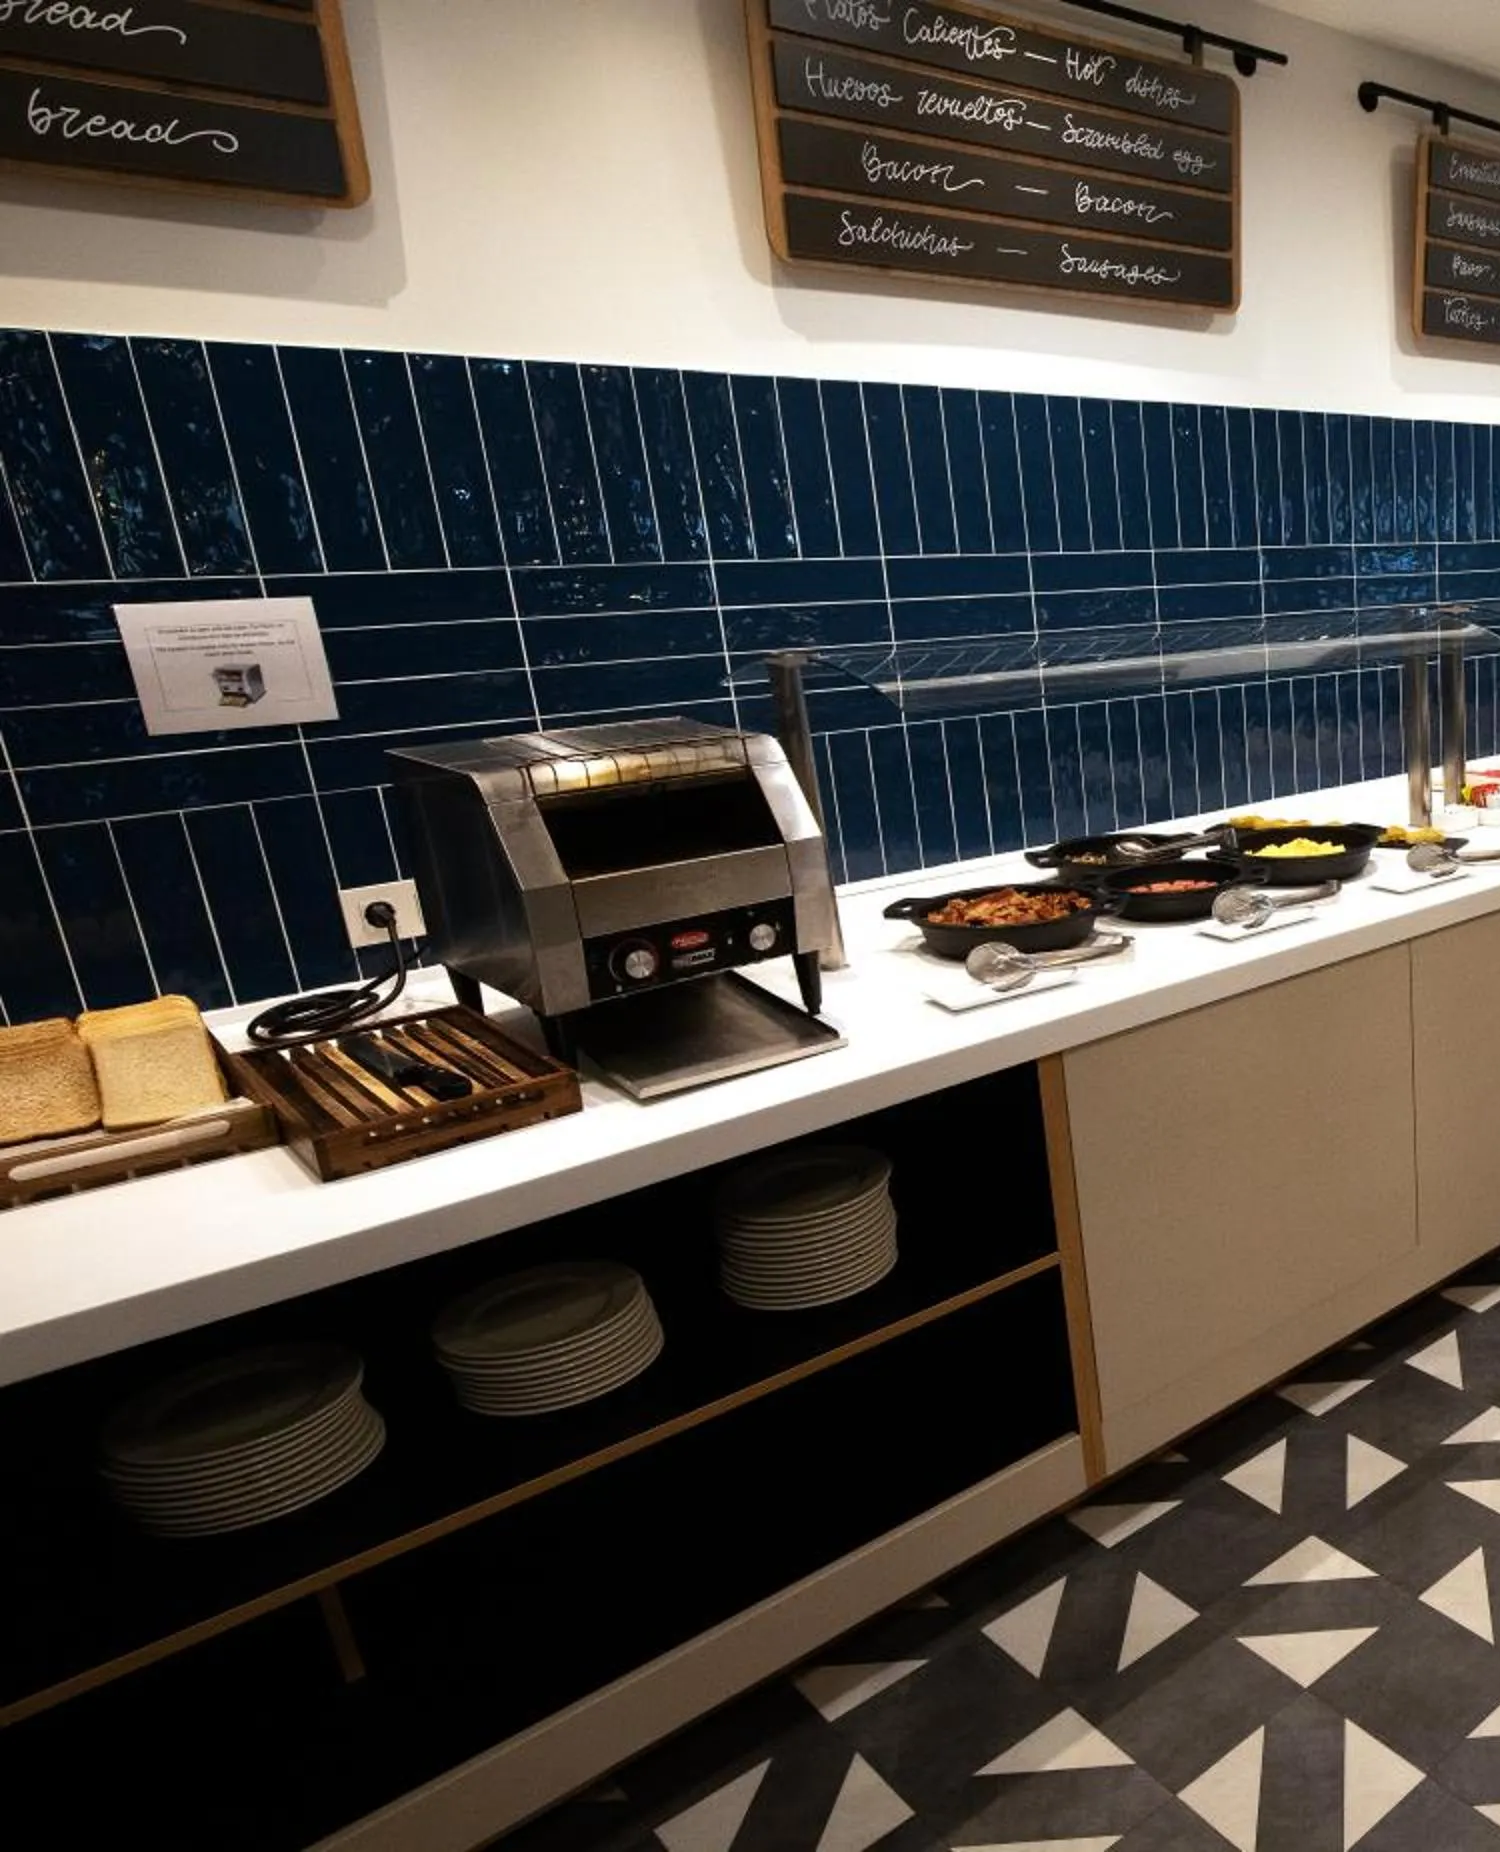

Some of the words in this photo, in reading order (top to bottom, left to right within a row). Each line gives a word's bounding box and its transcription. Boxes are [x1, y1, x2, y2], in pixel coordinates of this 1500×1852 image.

[903, 8, 1016, 61] Calientes
[1065, 47, 1117, 86] Hot
[27, 88, 239, 153] bread
[804, 56, 903, 108] Huevos
[917, 89, 1026, 131] revueltos
[1062, 113, 1165, 160] Scrambled
[861, 140, 986, 192] Bacon
[1074, 181, 1174, 224] Bacon
[838, 210, 976, 257] Salchichas
[1059, 243, 1182, 285] Sausages
